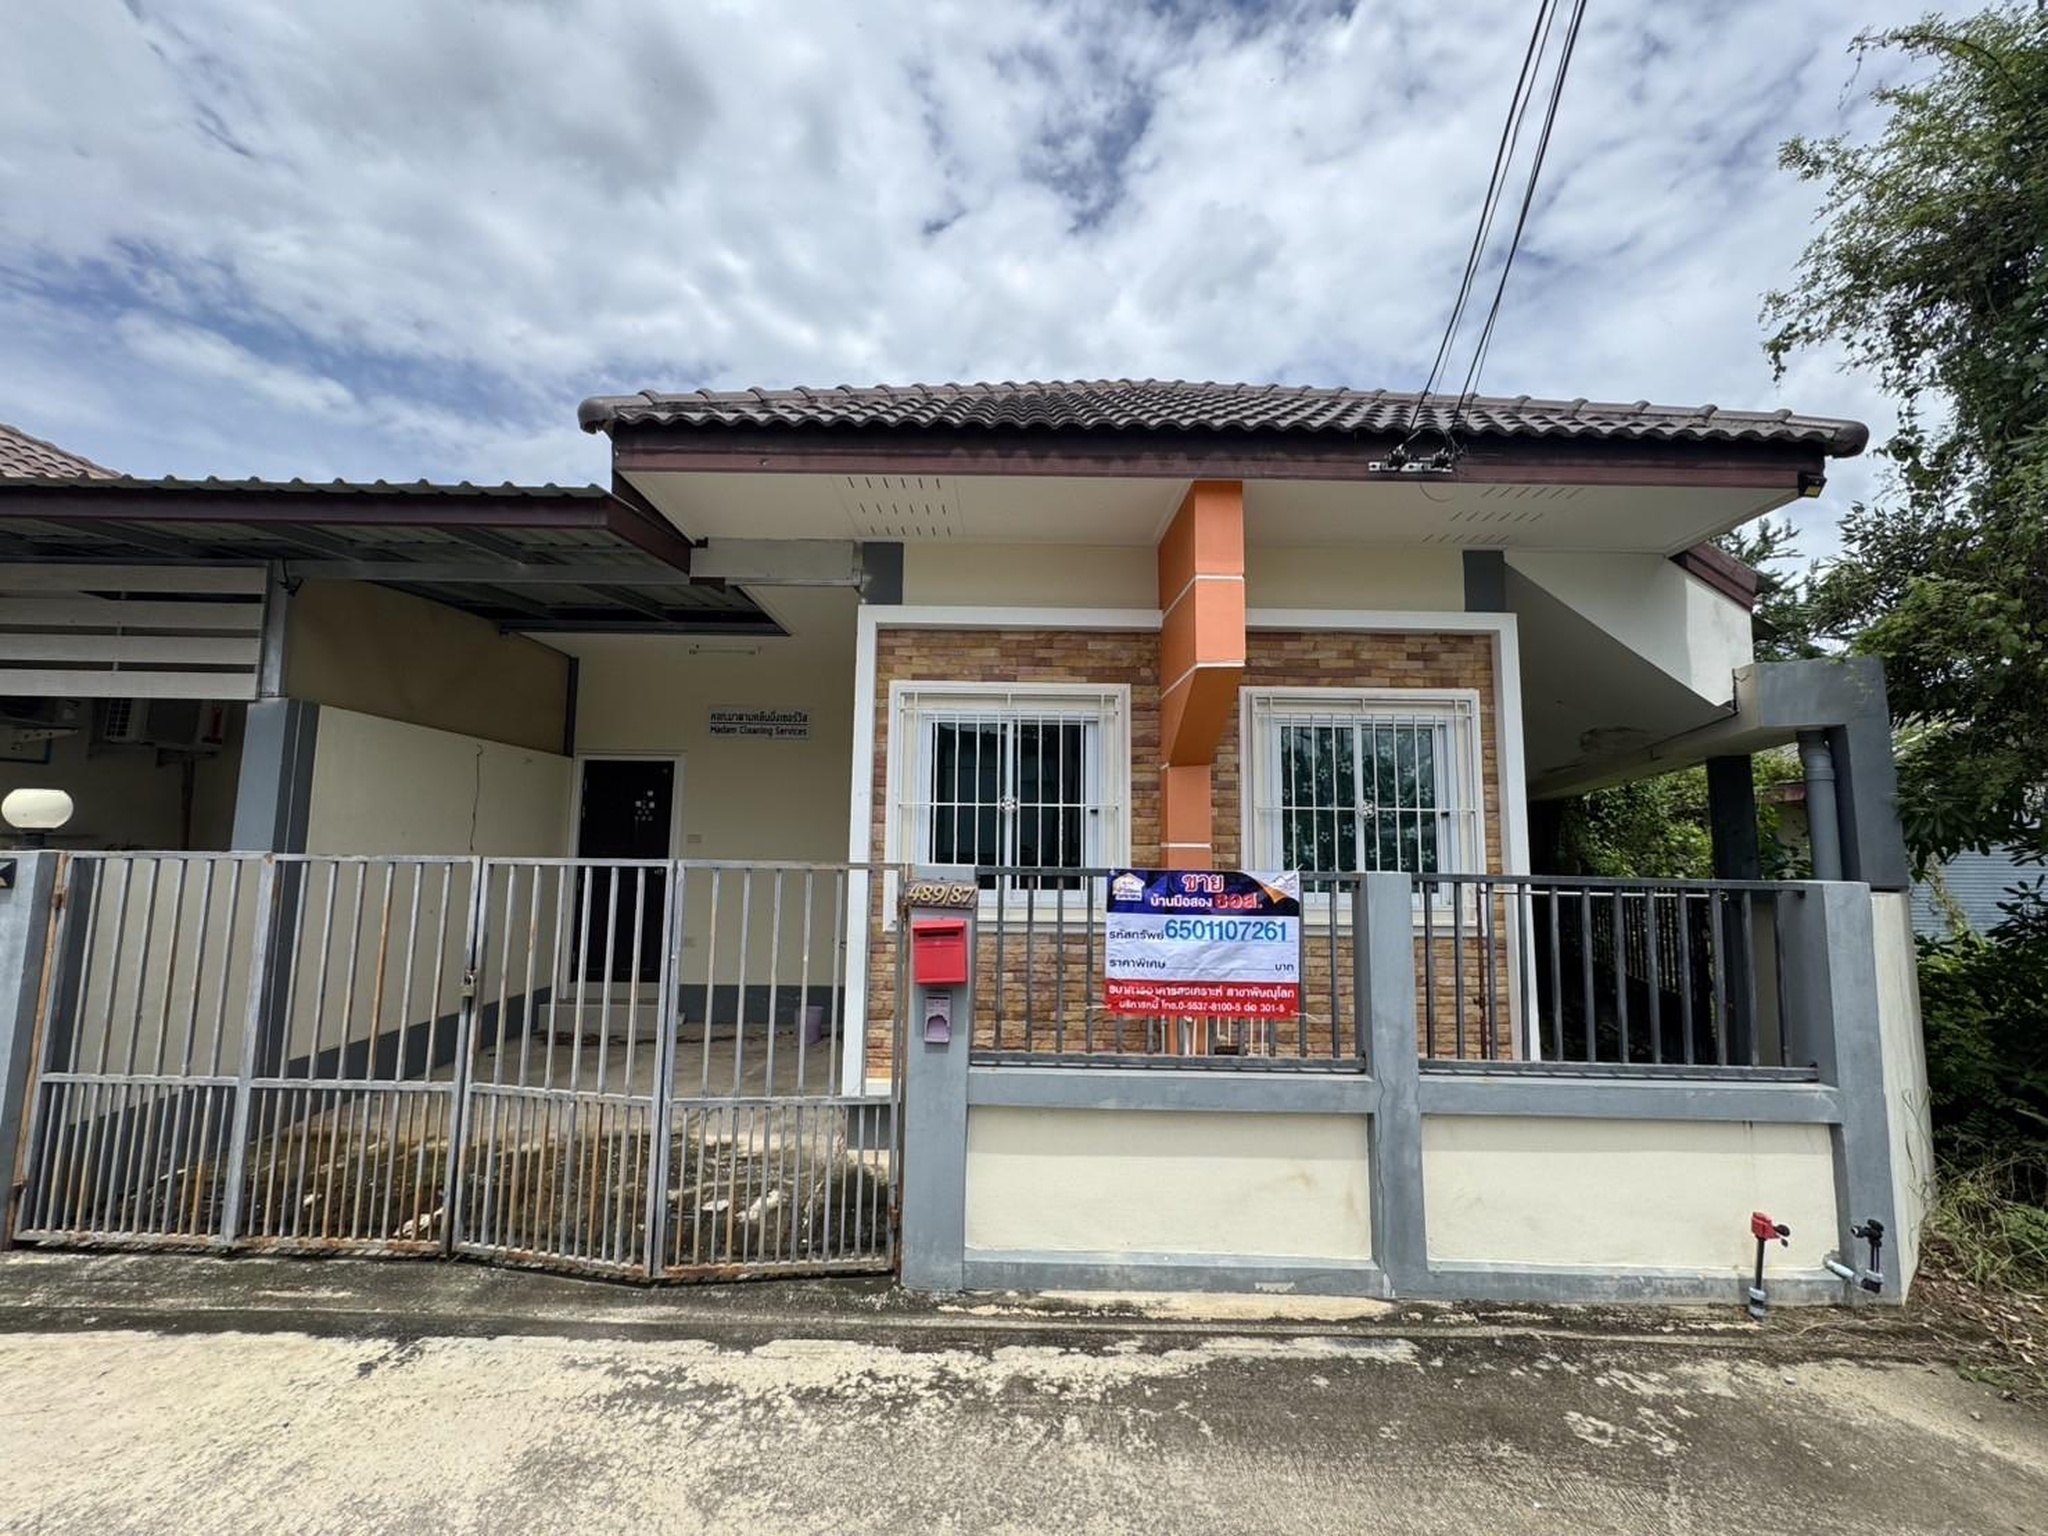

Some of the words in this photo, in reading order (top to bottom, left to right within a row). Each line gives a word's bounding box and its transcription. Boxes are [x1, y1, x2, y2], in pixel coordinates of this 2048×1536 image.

[710, 725, 737, 734] Madam
[740, 726, 773, 737] Cleaning
[775, 727, 807, 737] Services
[1181, 873, 1224, 893] ขาย
[908, 884, 977, 904] 489/87
[1150, 893, 1213, 908] บ้านมือสอง
[1109, 928, 1164, 940] รหัสทรัพย์
[1164, 919, 1287, 942] 6501107261
[1109, 957, 1166, 969] ราคาพิเศษ
[1275, 963, 1294, 972] บาท
